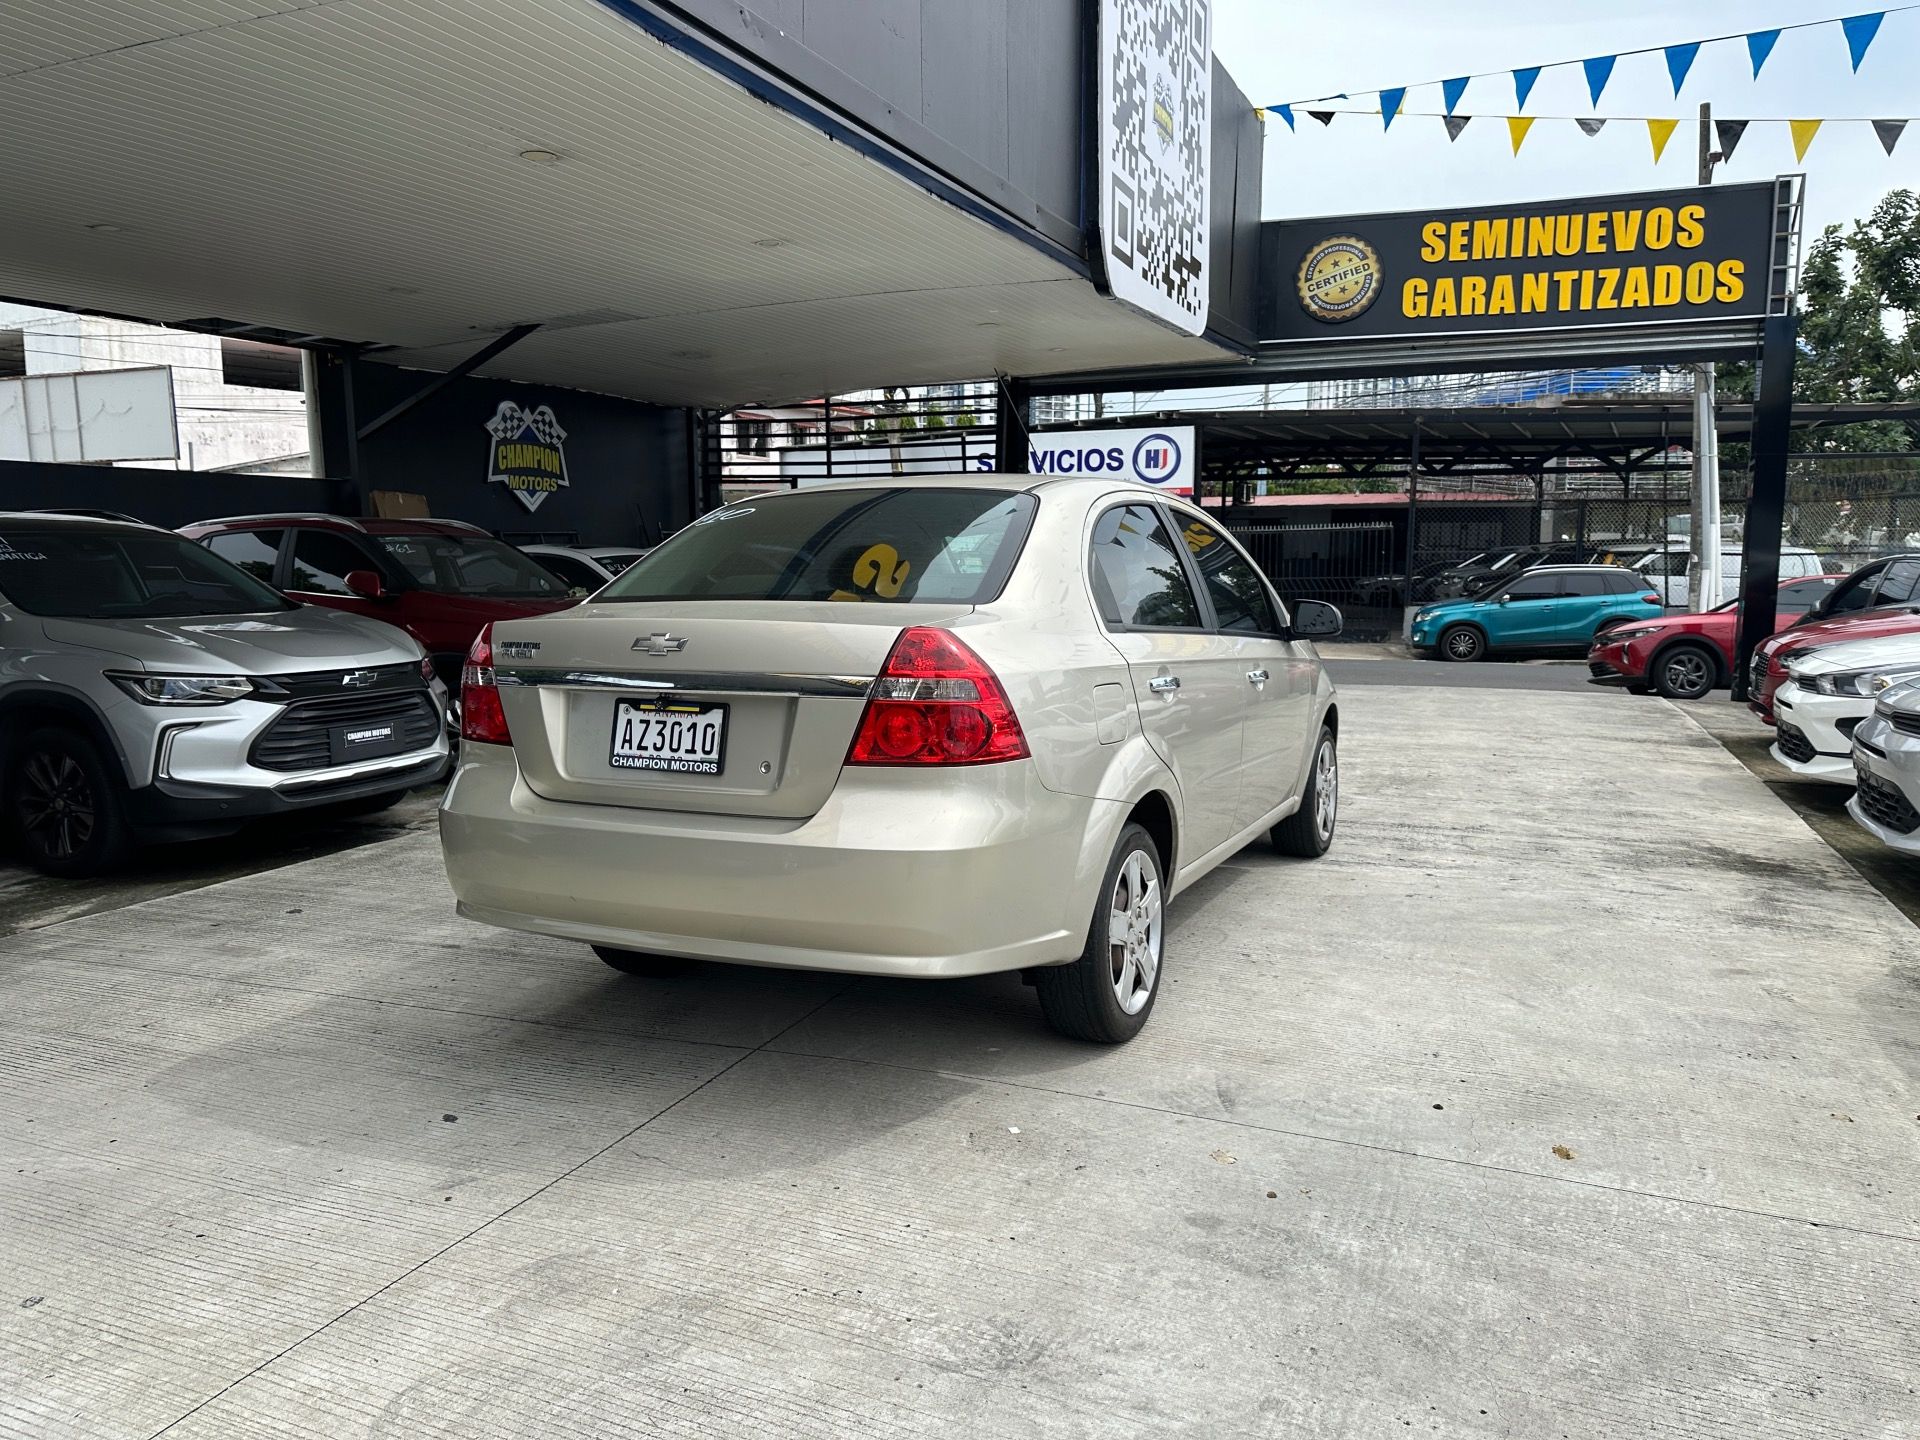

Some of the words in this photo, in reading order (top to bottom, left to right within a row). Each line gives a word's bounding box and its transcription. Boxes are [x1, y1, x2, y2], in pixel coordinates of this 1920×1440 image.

[1420, 204, 1707, 264] SEMINUEVOS
[1307, 253, 1325, 279] CERTIFIED
[1324, 245, 1364, 259] PROFESSIONAL
[1307, 262, 1371, 293] CERTIFIED
[1401, 258, 1746, 319] GARANTIZADOS
[498, 444, 561, 475] CHAMPION
[977, 448, 1124, 474] SVICIOS
[509, 475, 558, 492] MOTORS
[501, 641, 522, 649] CHAMPION
[522, 642, 541, 650] MOTORS
[348, 730, 372, 740] CHAMPION
[372, 727, 391, 737] MOTORS
[620, 718, 716, 756] AZ3010
[612, 756, 668, 770] CHAMPION
[670, 760, 718, 773] MOTORS
